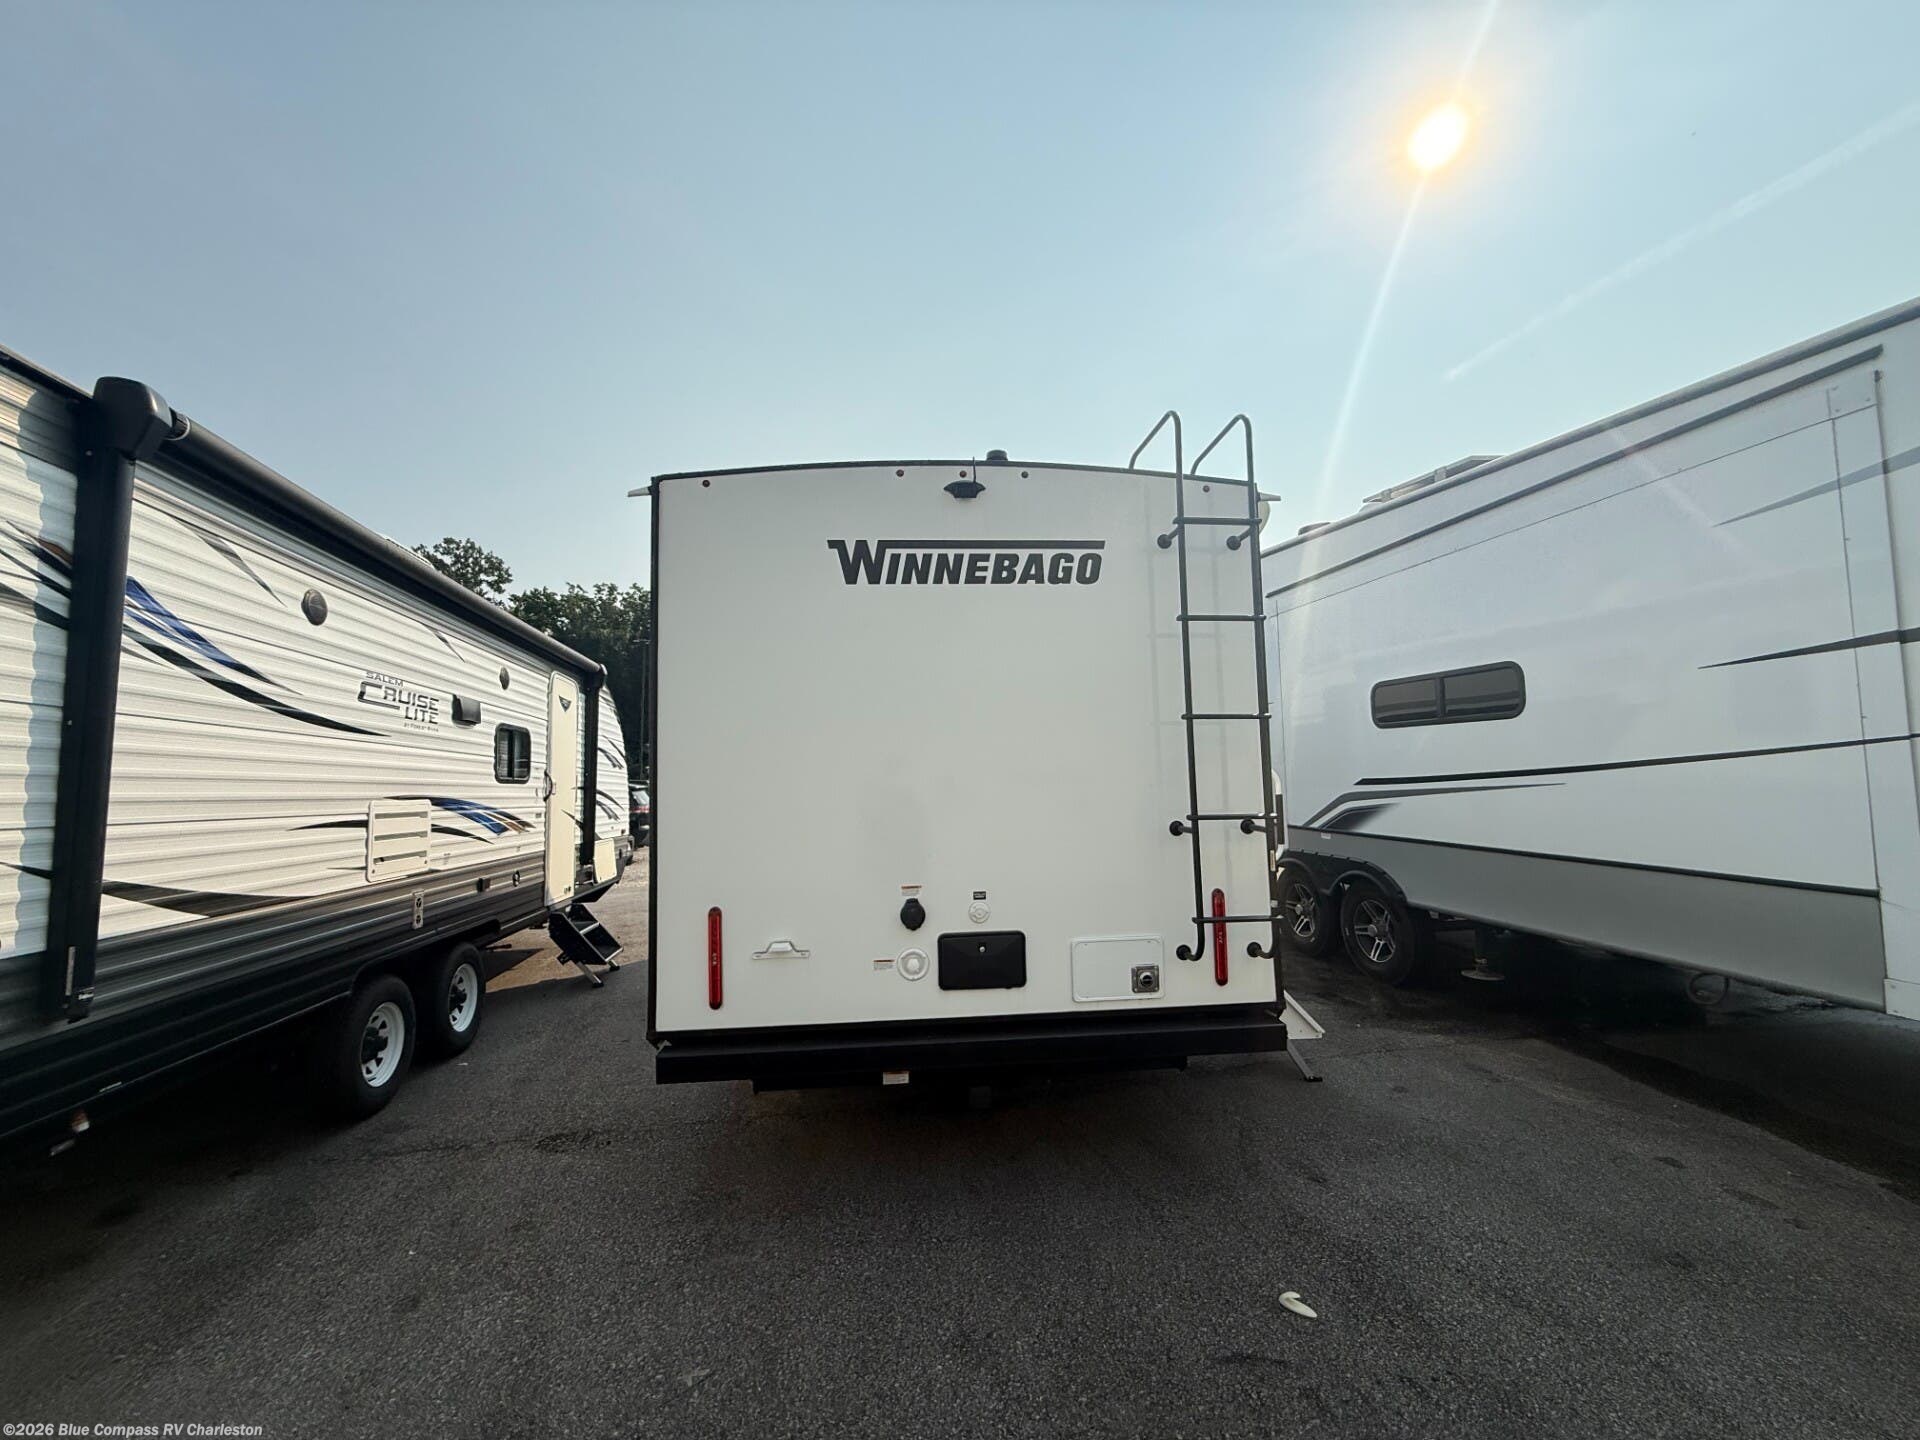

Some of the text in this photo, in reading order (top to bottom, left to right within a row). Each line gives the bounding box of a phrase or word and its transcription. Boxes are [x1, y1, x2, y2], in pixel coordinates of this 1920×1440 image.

[827, 540, 1105, 584] WINNEBAGO
[366, 671, 404, 687] SALEM
[357, 681, 439, 711] CRUISE
[404, 706, 439, 724] LITE
